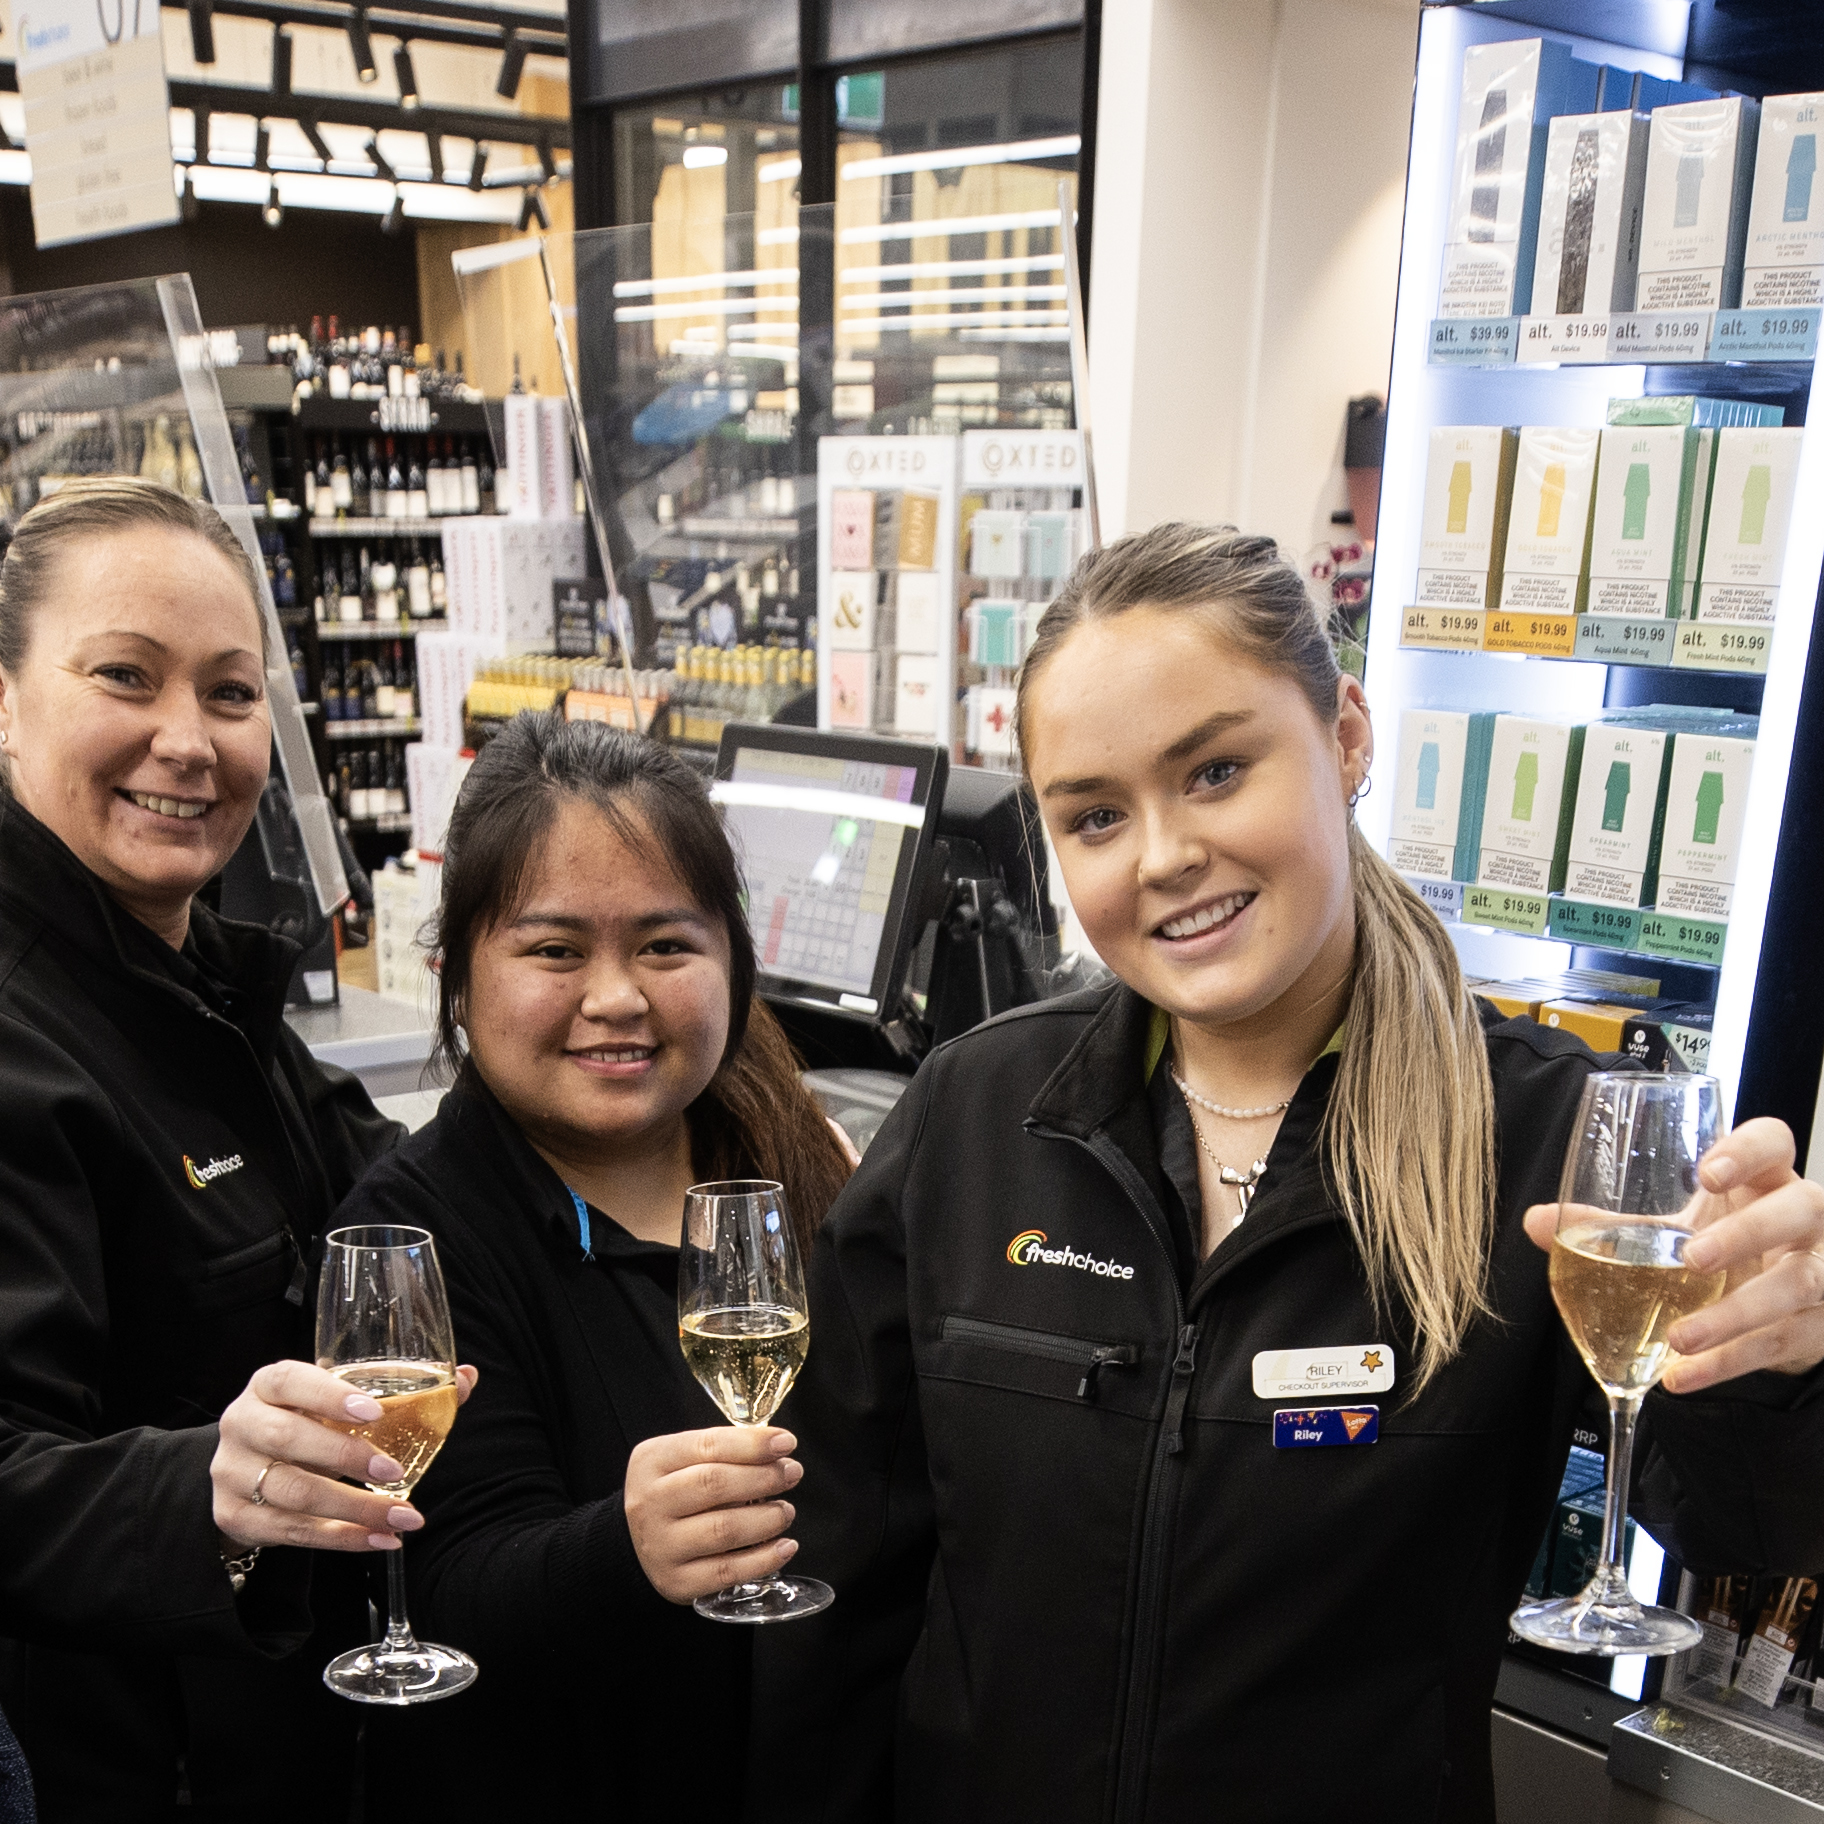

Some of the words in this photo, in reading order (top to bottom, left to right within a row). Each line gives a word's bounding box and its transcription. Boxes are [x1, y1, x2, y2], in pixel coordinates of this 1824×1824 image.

[1436, 325, 1458, 343] alt.
[1470, 325, 1509, 340] $39.99
[1529, 323, 1551, 339] alt.
[1566, 323, 1607, 338] $19.99
[1616, 322, 1641, 339] alt.
[1655, 322, 1699, 337] $19.99
[1720, 319, 1747, 335] alt.
[1762, 319, 1809, 335] $19.99
[982, 440, 1076, 477] OXTED
[1408, 613, 1428, 628] alt.
[1441, 616, 1478, 630] $19.99
[1494, 619, 1513, 633] alt.
[1531, 622, 1567, 636] $19.99
[1582, 623, 1604, 638] alt.
[1624, 626, 1665, 641] $19.99
[1683, 632, 1706, 647] alt.
[1721, 634, 1765, 650] $19.99
[1687, 652, 1704, 660] Fresh
[1614, 740, 1633, 753] alt.
[1706, 750, 1724, 763] alt.
[1590, 837, 1631, 849] SPEARMINT
[1678, 850, 1728, 861] PEPPERMINT
[1421, 885, 1453, 900] $19.99
[1471, 894, 1491, 908] alt.
[1504, 898, 1541, 914] $19.99
[1559, 906, 1580, 922] alt.
[1592, 911, 1631, 928] $19.99
[1643, 921, 1666, 937] alt.
[1679, 926, 1719, 945] $19.99
[1026, 1242, 1134, 1280] freshchoice
[1310, 1365, 1343, 1377] RILEY
[1278, 1381, 1318, 1391] CHECKOUT
[1320, 1379, 1368, 1389] SUPERVISOR
[1294, 1429, 1323, 1442] Riley
